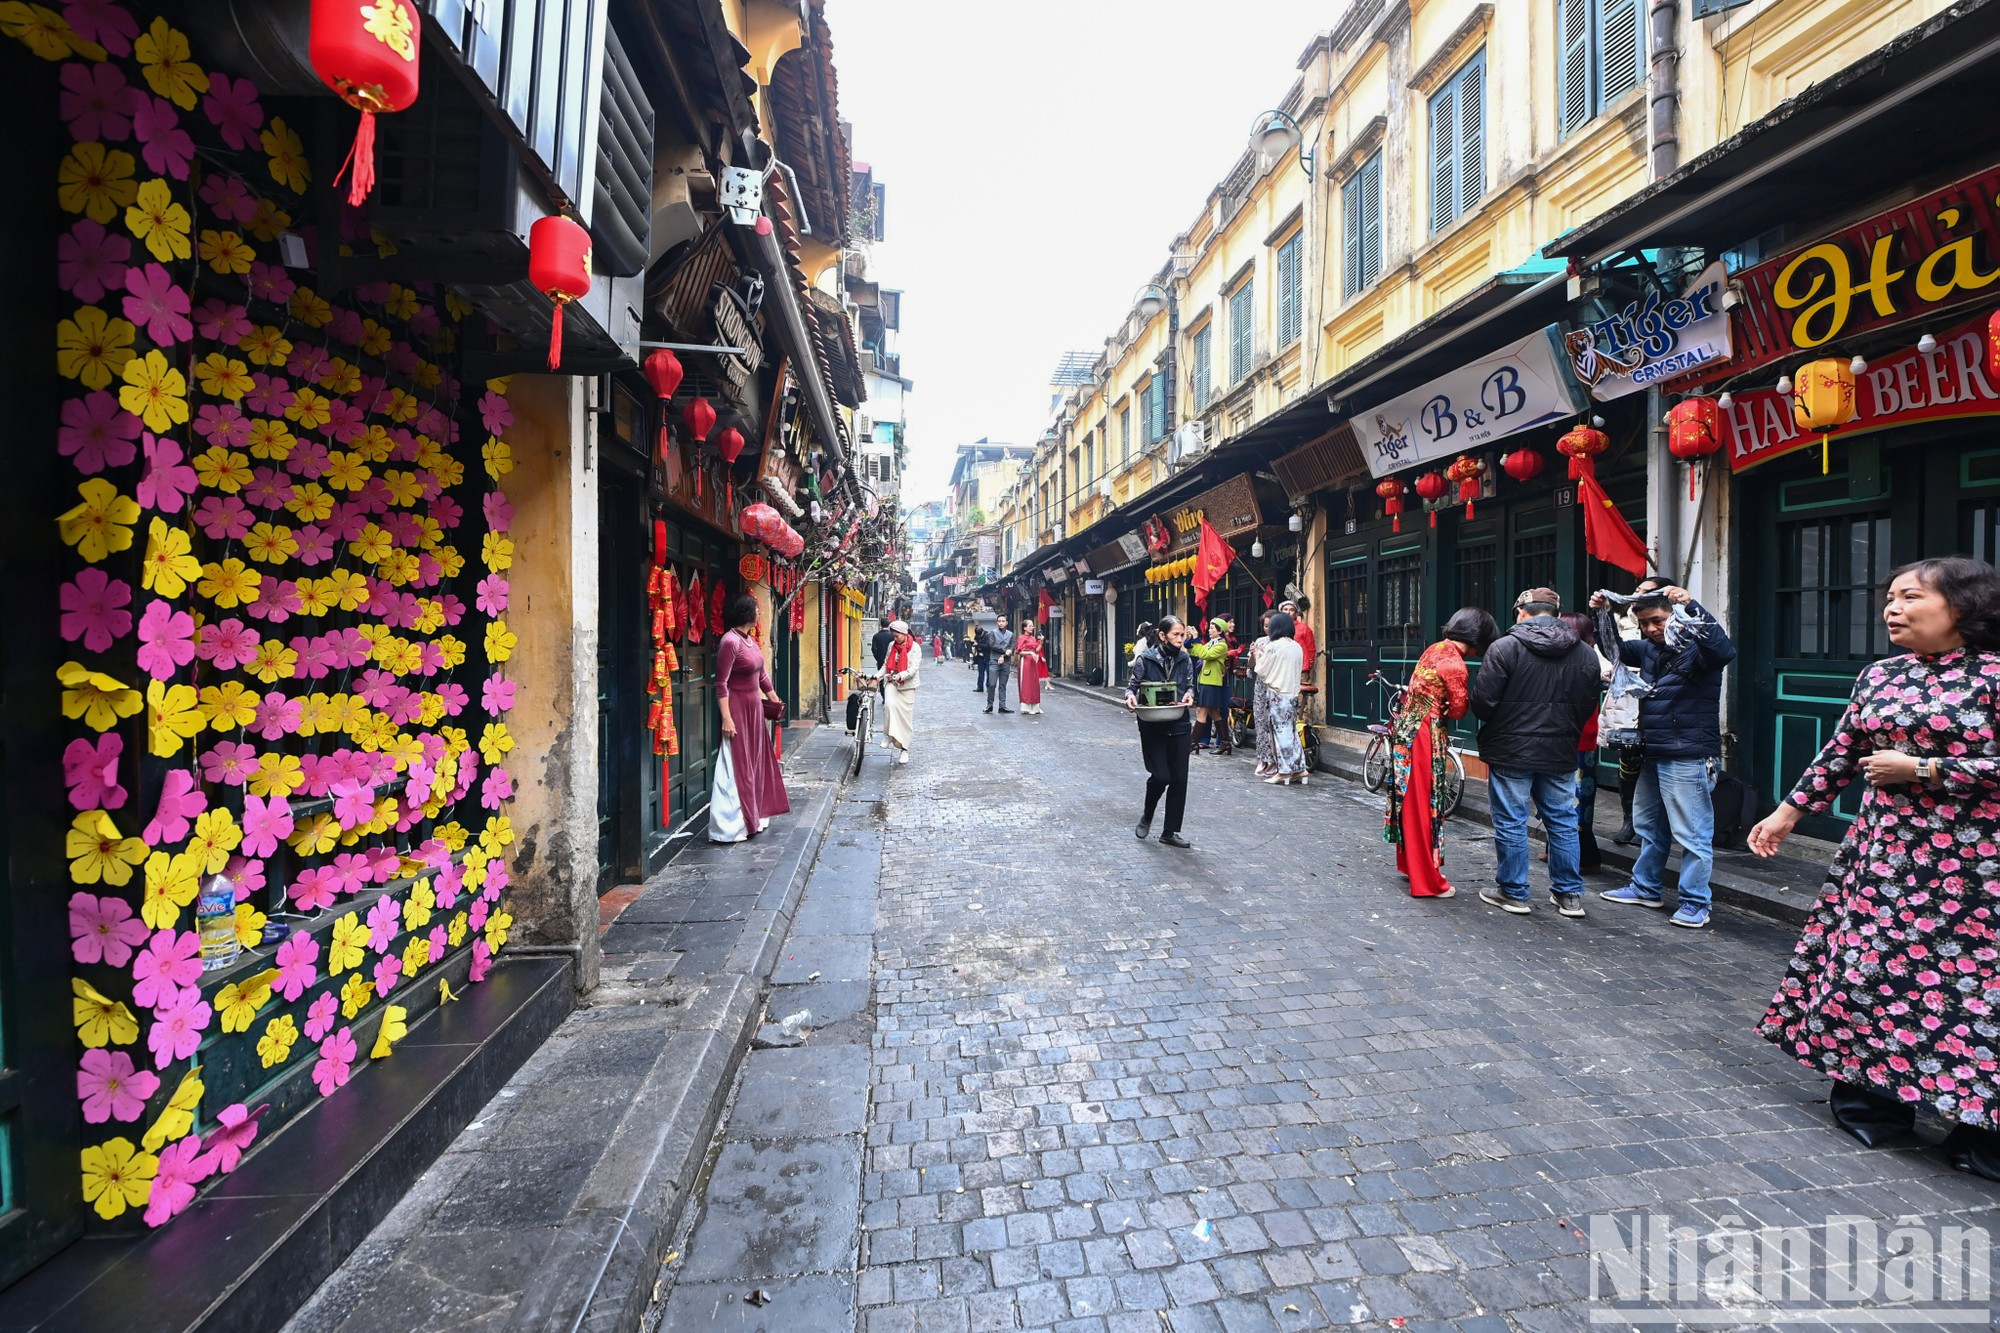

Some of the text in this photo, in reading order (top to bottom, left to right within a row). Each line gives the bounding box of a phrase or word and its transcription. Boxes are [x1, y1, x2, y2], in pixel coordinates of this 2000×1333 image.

[1773, 192, 2000, 349] Hả
[1595, 281, 1719, 358] Tiger
[1632, 347, 1712, 384] CRYSTAL
[1866, 331, 1999, 418] BEER
[1420, 365, 1527, 443] B & B
[1374, 434, 1409, 459] Tiger
[1388, 458, 1411, 470] CRYSTAL
[1556, 489, 1570, 505] 19
[1173, 507, 1204, 533] Olive
[1346, 521, 1355, 532] 19
